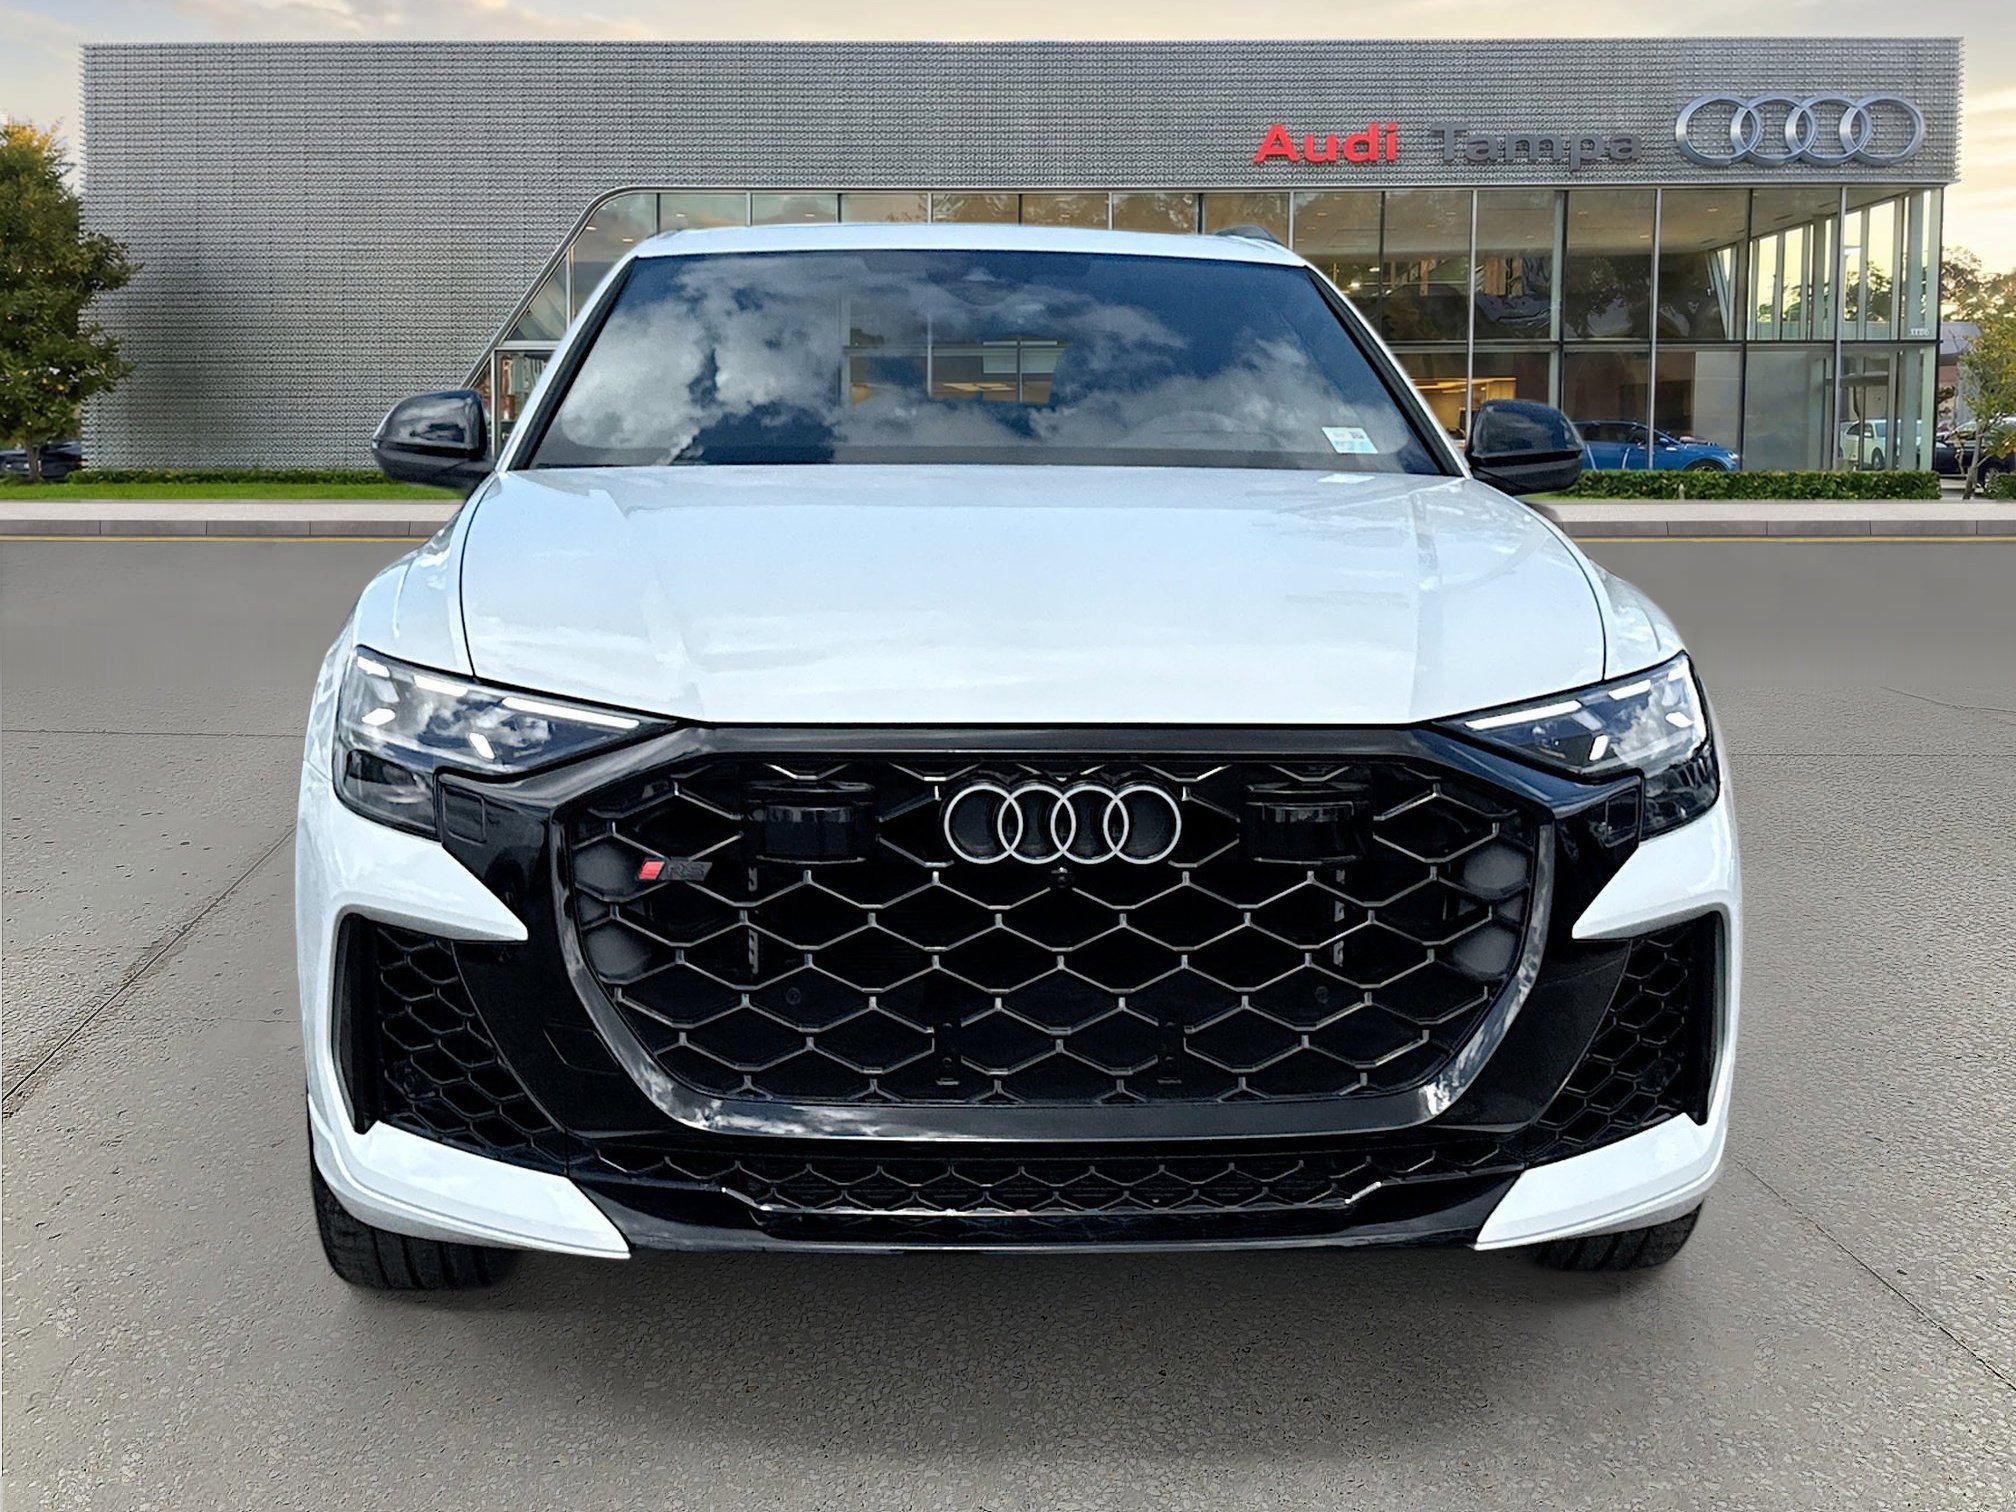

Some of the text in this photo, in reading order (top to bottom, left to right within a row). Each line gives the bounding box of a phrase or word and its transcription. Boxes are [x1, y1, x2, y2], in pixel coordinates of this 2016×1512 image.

[1253, 121, 1642, 172] Audi Tampa
[665, 861, 706, 880] RS
